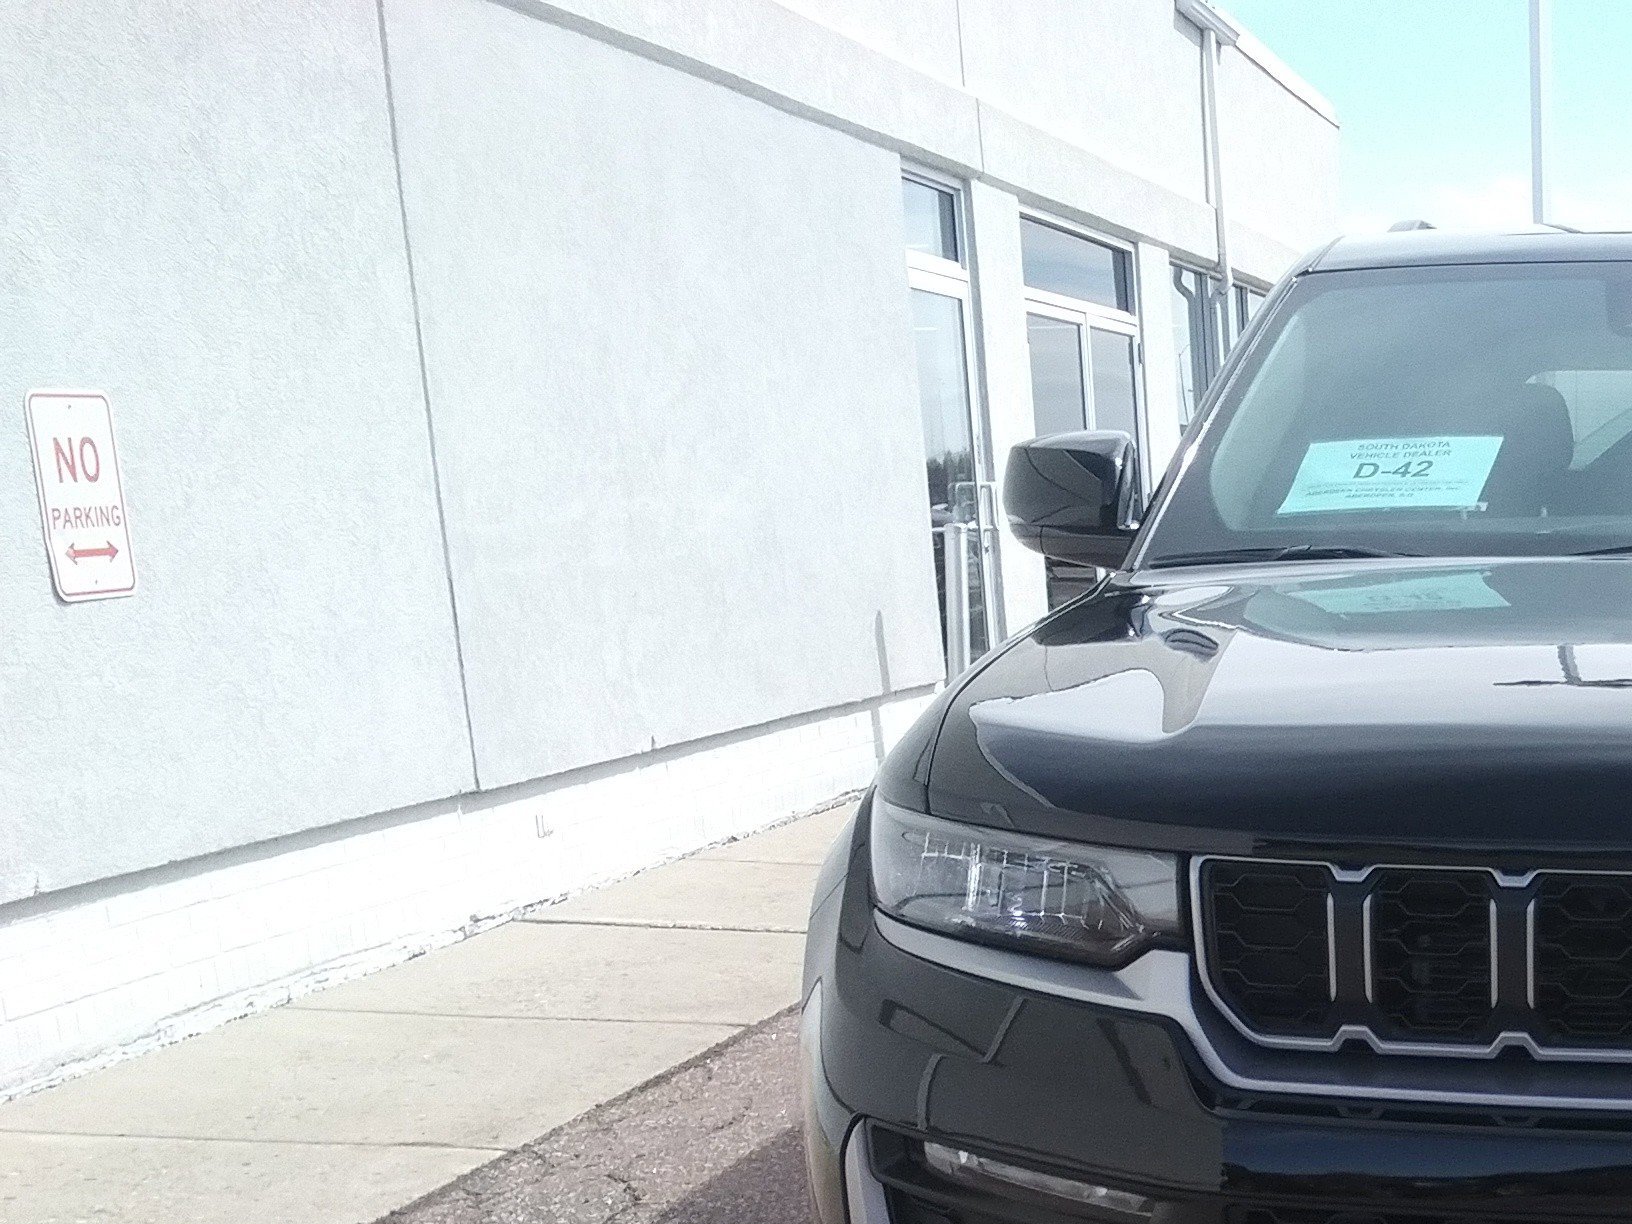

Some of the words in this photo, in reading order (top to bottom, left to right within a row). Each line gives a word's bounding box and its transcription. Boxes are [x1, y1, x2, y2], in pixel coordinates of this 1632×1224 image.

[1350, 452, 1401, 460] VEHICLE
[1403, 450, 1452, 458] DEALER
[1357, 443, 1399, 451] SOUTH
[1402, 441, 1450, 450] DAKOTA
[53, 436, 100, 483] NO
[1353, 460, 1434, 479] D-42
[51, 506, 121, 530] PARKING
